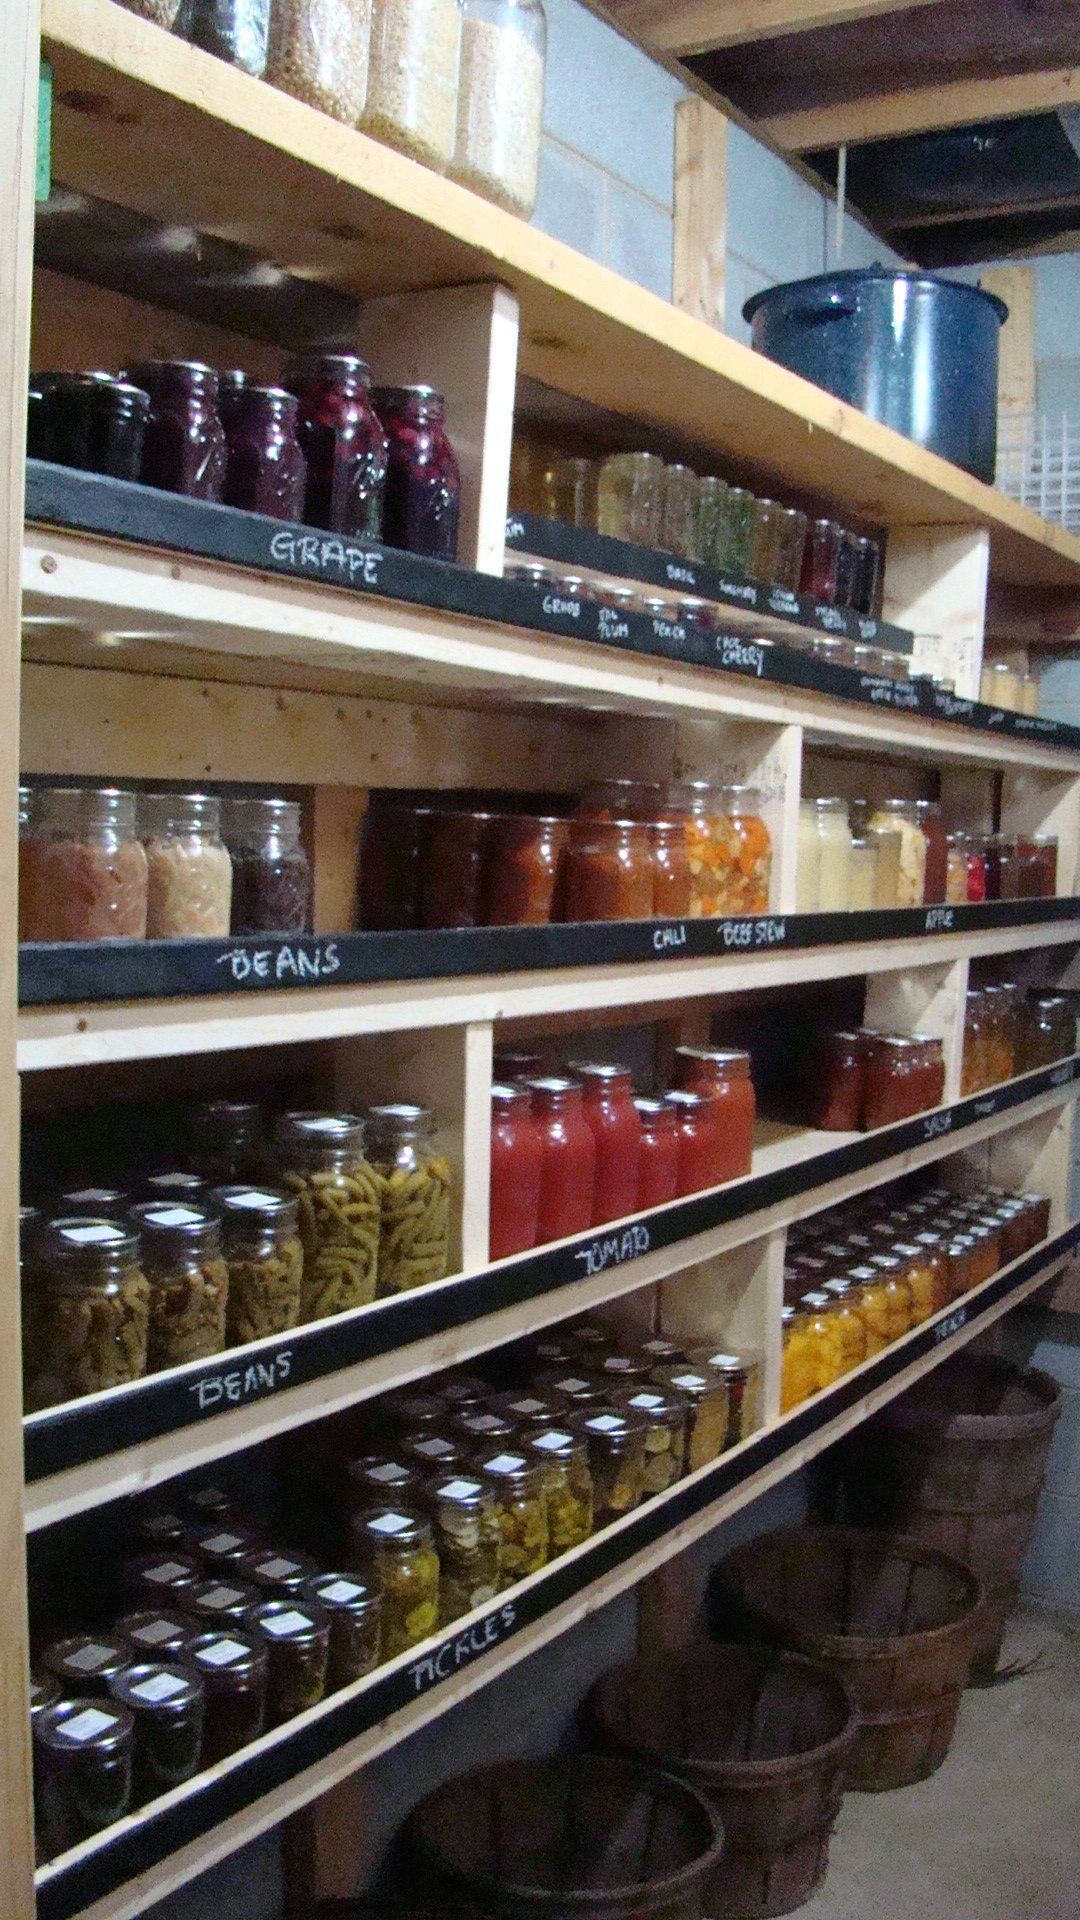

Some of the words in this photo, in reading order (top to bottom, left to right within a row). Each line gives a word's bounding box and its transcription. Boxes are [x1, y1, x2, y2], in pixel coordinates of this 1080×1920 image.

[270, 532, 384, 585] GRAPE
[755, 918, 787, 945] STEW
[216, 943, 341, 981] BEANS
[574, 1224, 650, 1275] TOMATO
[189, 1350, 293, 1409] BEANS
[407, 1603, 516, 1691] PICKLES
